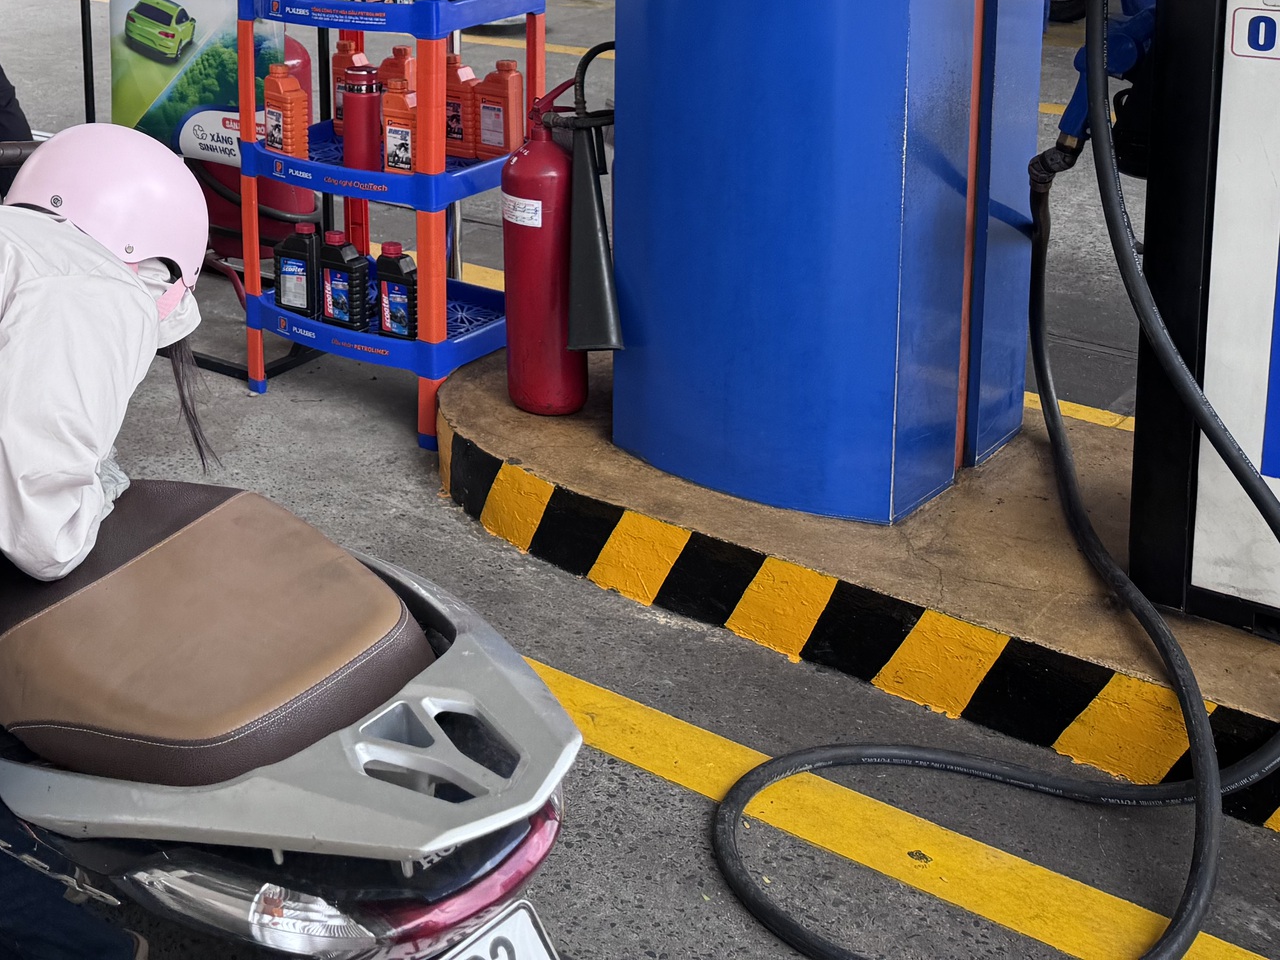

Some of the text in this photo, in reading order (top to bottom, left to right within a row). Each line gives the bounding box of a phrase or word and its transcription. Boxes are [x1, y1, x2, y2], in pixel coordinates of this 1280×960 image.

[199, 142, 236, 157] SINH HỌC
[209, 130, 234, 145] XĂNG
[325, 281, 333, 314] scooter
[382, 294, 391, 328] scooter
